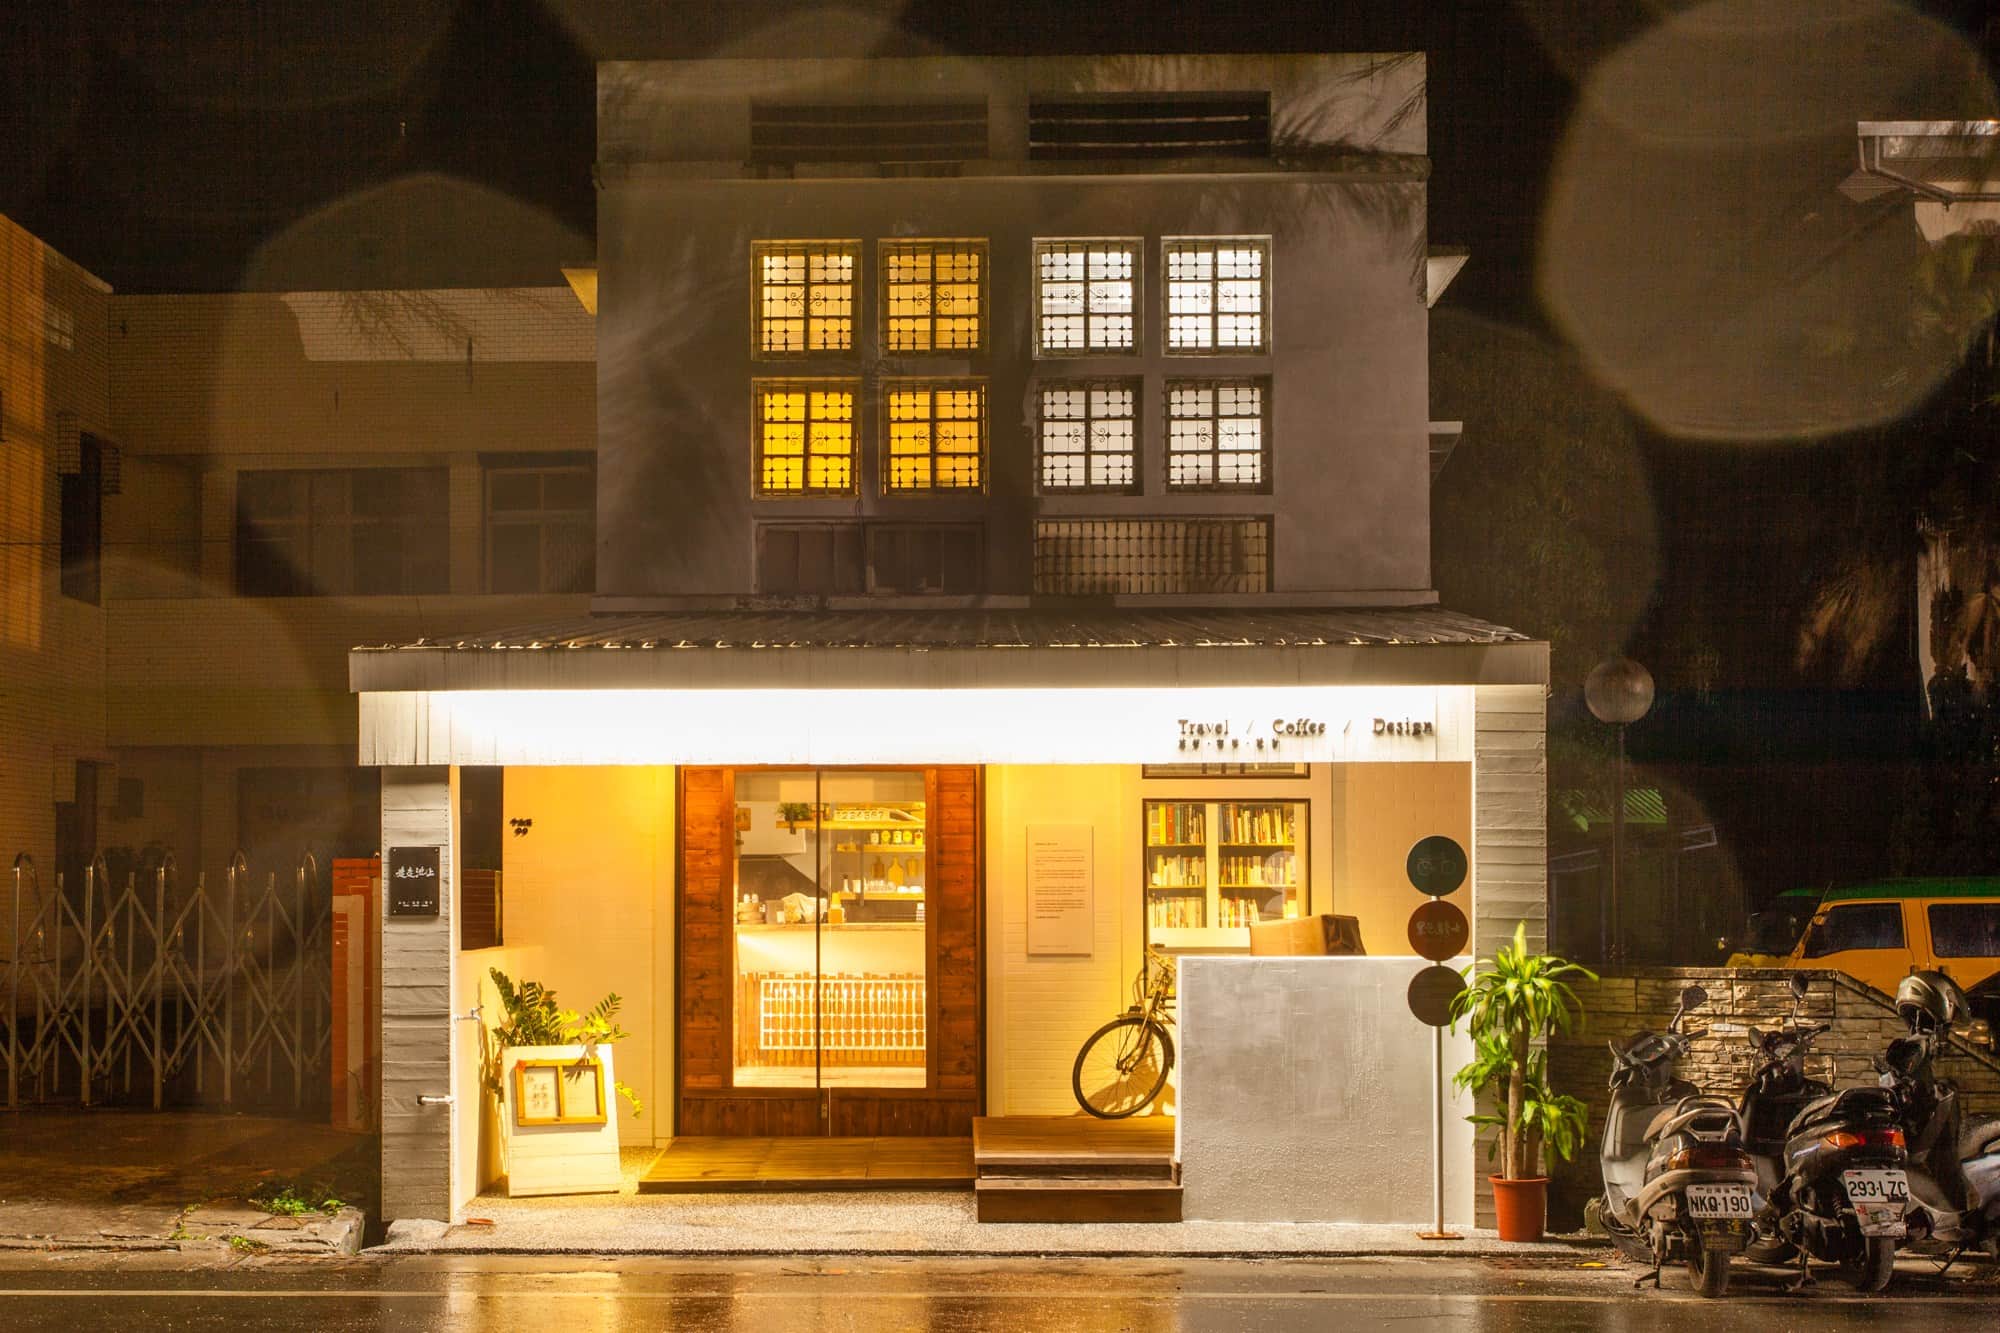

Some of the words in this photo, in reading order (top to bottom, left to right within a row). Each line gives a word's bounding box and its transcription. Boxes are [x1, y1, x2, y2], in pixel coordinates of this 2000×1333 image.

[1178, 719, 1229, 735] Travel
[1272, 718, 1326, 735] Coffee
[1373, 717, 1433, 737] Design
